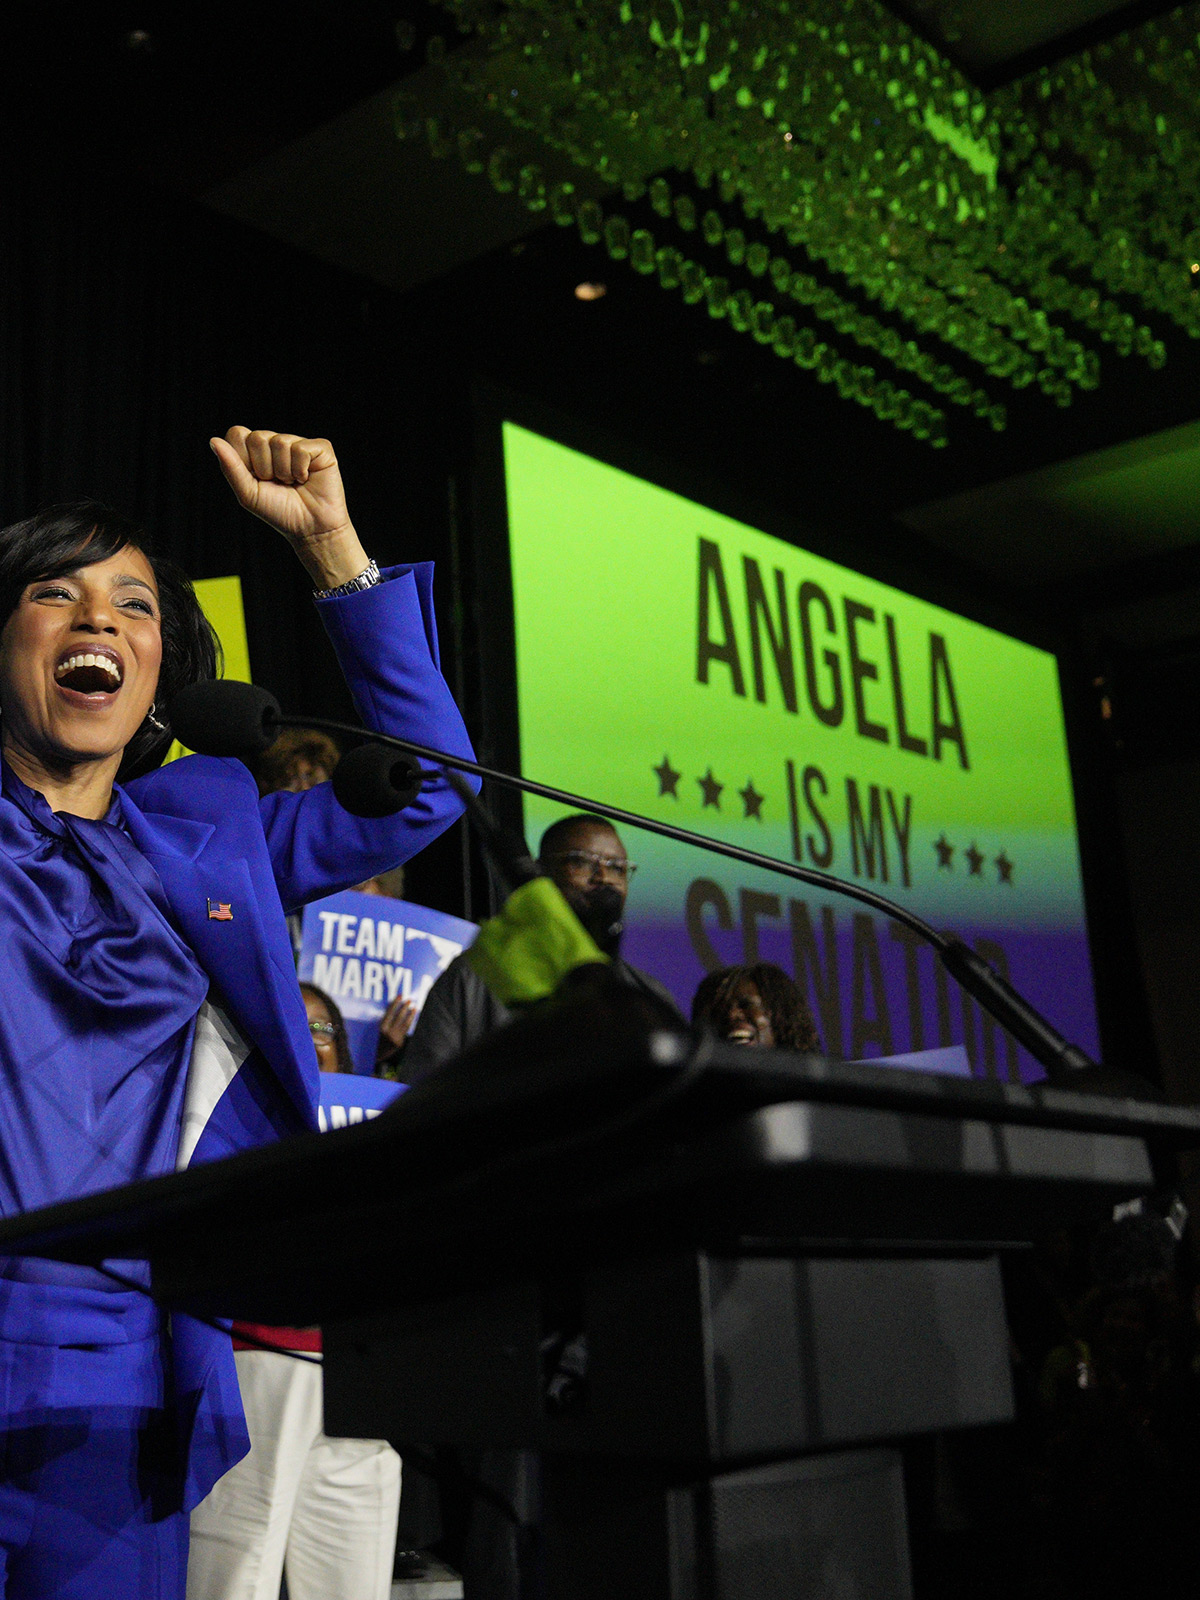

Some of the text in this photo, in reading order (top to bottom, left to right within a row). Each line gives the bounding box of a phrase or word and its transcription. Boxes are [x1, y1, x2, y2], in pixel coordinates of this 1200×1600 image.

[694, 534, 972, 772] ANGELA
[785, 758, 914, 889] IS MY
[318, 911, 406, 964] TEAM
